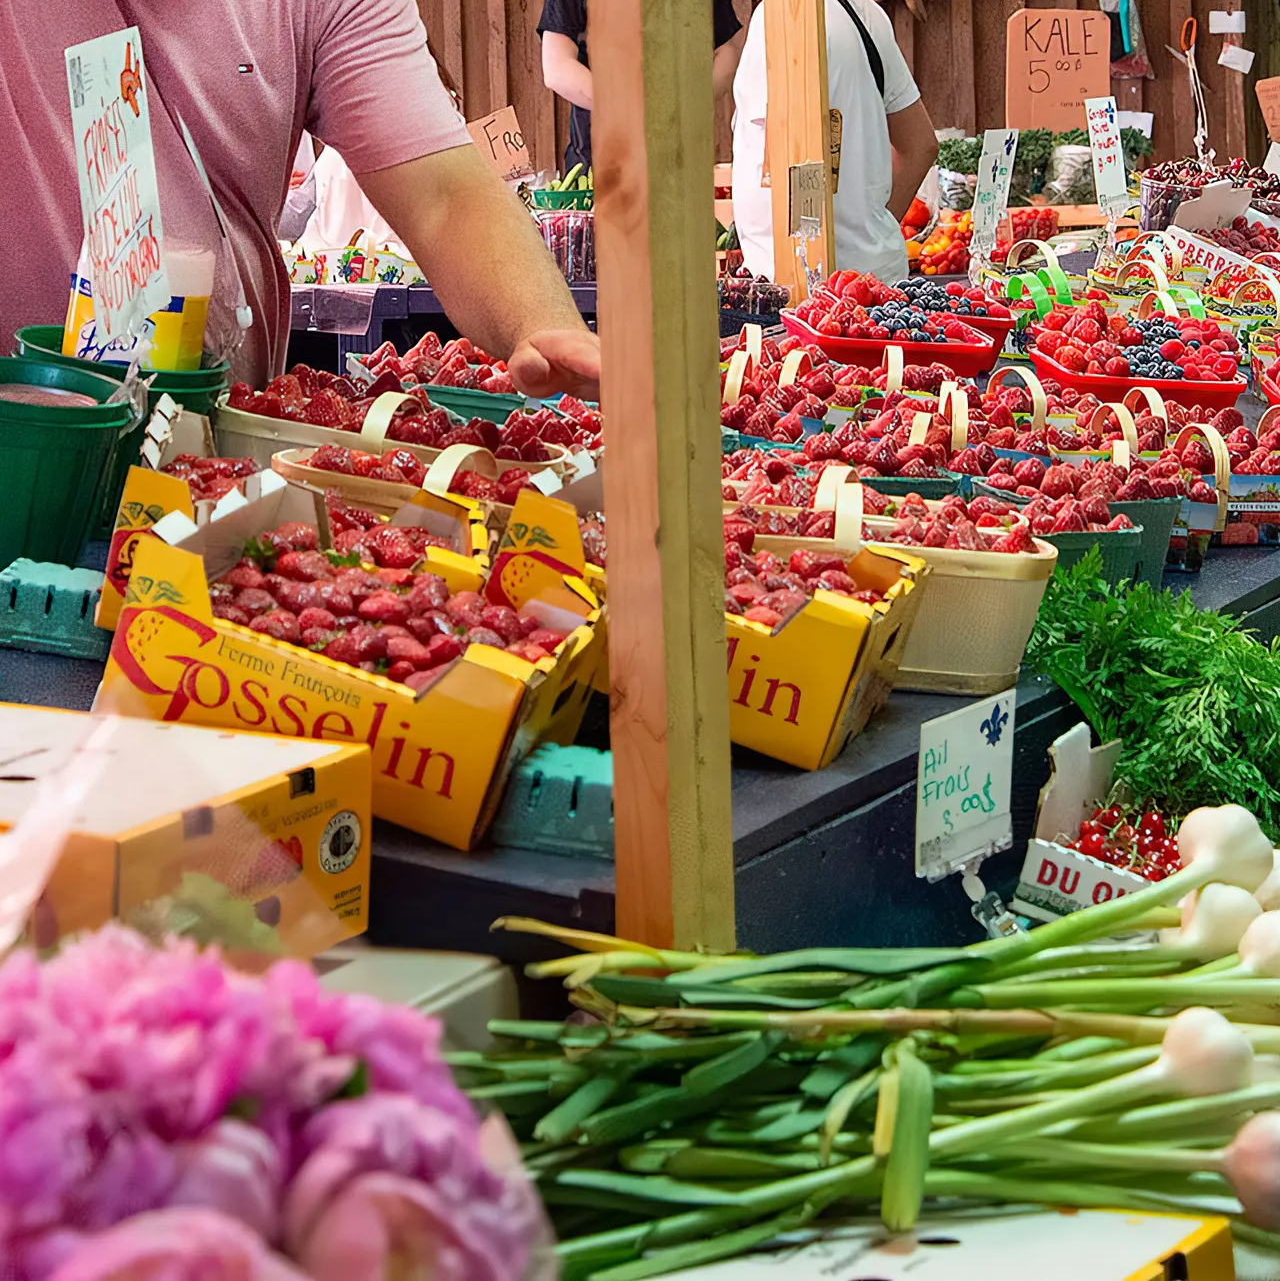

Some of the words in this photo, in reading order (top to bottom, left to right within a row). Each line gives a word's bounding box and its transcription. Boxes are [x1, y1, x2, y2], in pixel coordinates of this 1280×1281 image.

[1024, 14, 1098, 56] KALE
[217, 634, 275, 676] Ferme
[924, 739, 948, 778] Ail
[922, 765, 970, 807] Frais
[1036, 858, 1081, 895] DU
